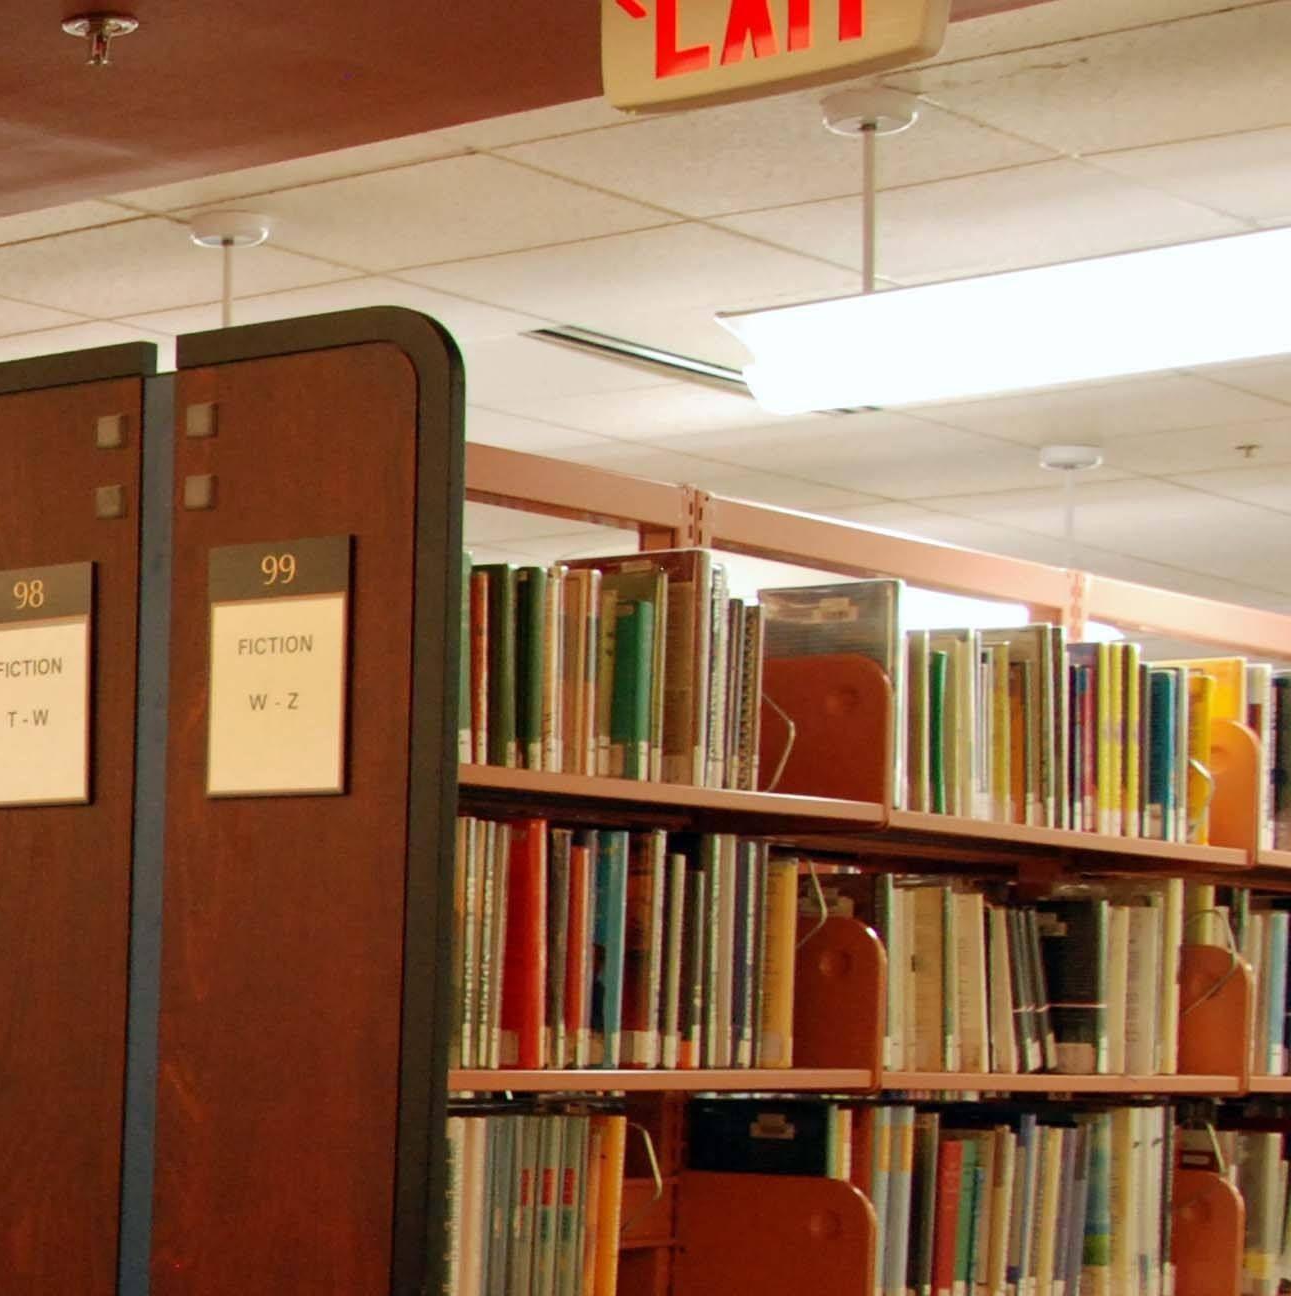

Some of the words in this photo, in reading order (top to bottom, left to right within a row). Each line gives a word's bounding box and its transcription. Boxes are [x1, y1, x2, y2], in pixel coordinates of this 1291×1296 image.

[261, 554, 296, 585] 99
[13, 579, 44, 609] 98
[237, 634, 313, 656] FICTION
